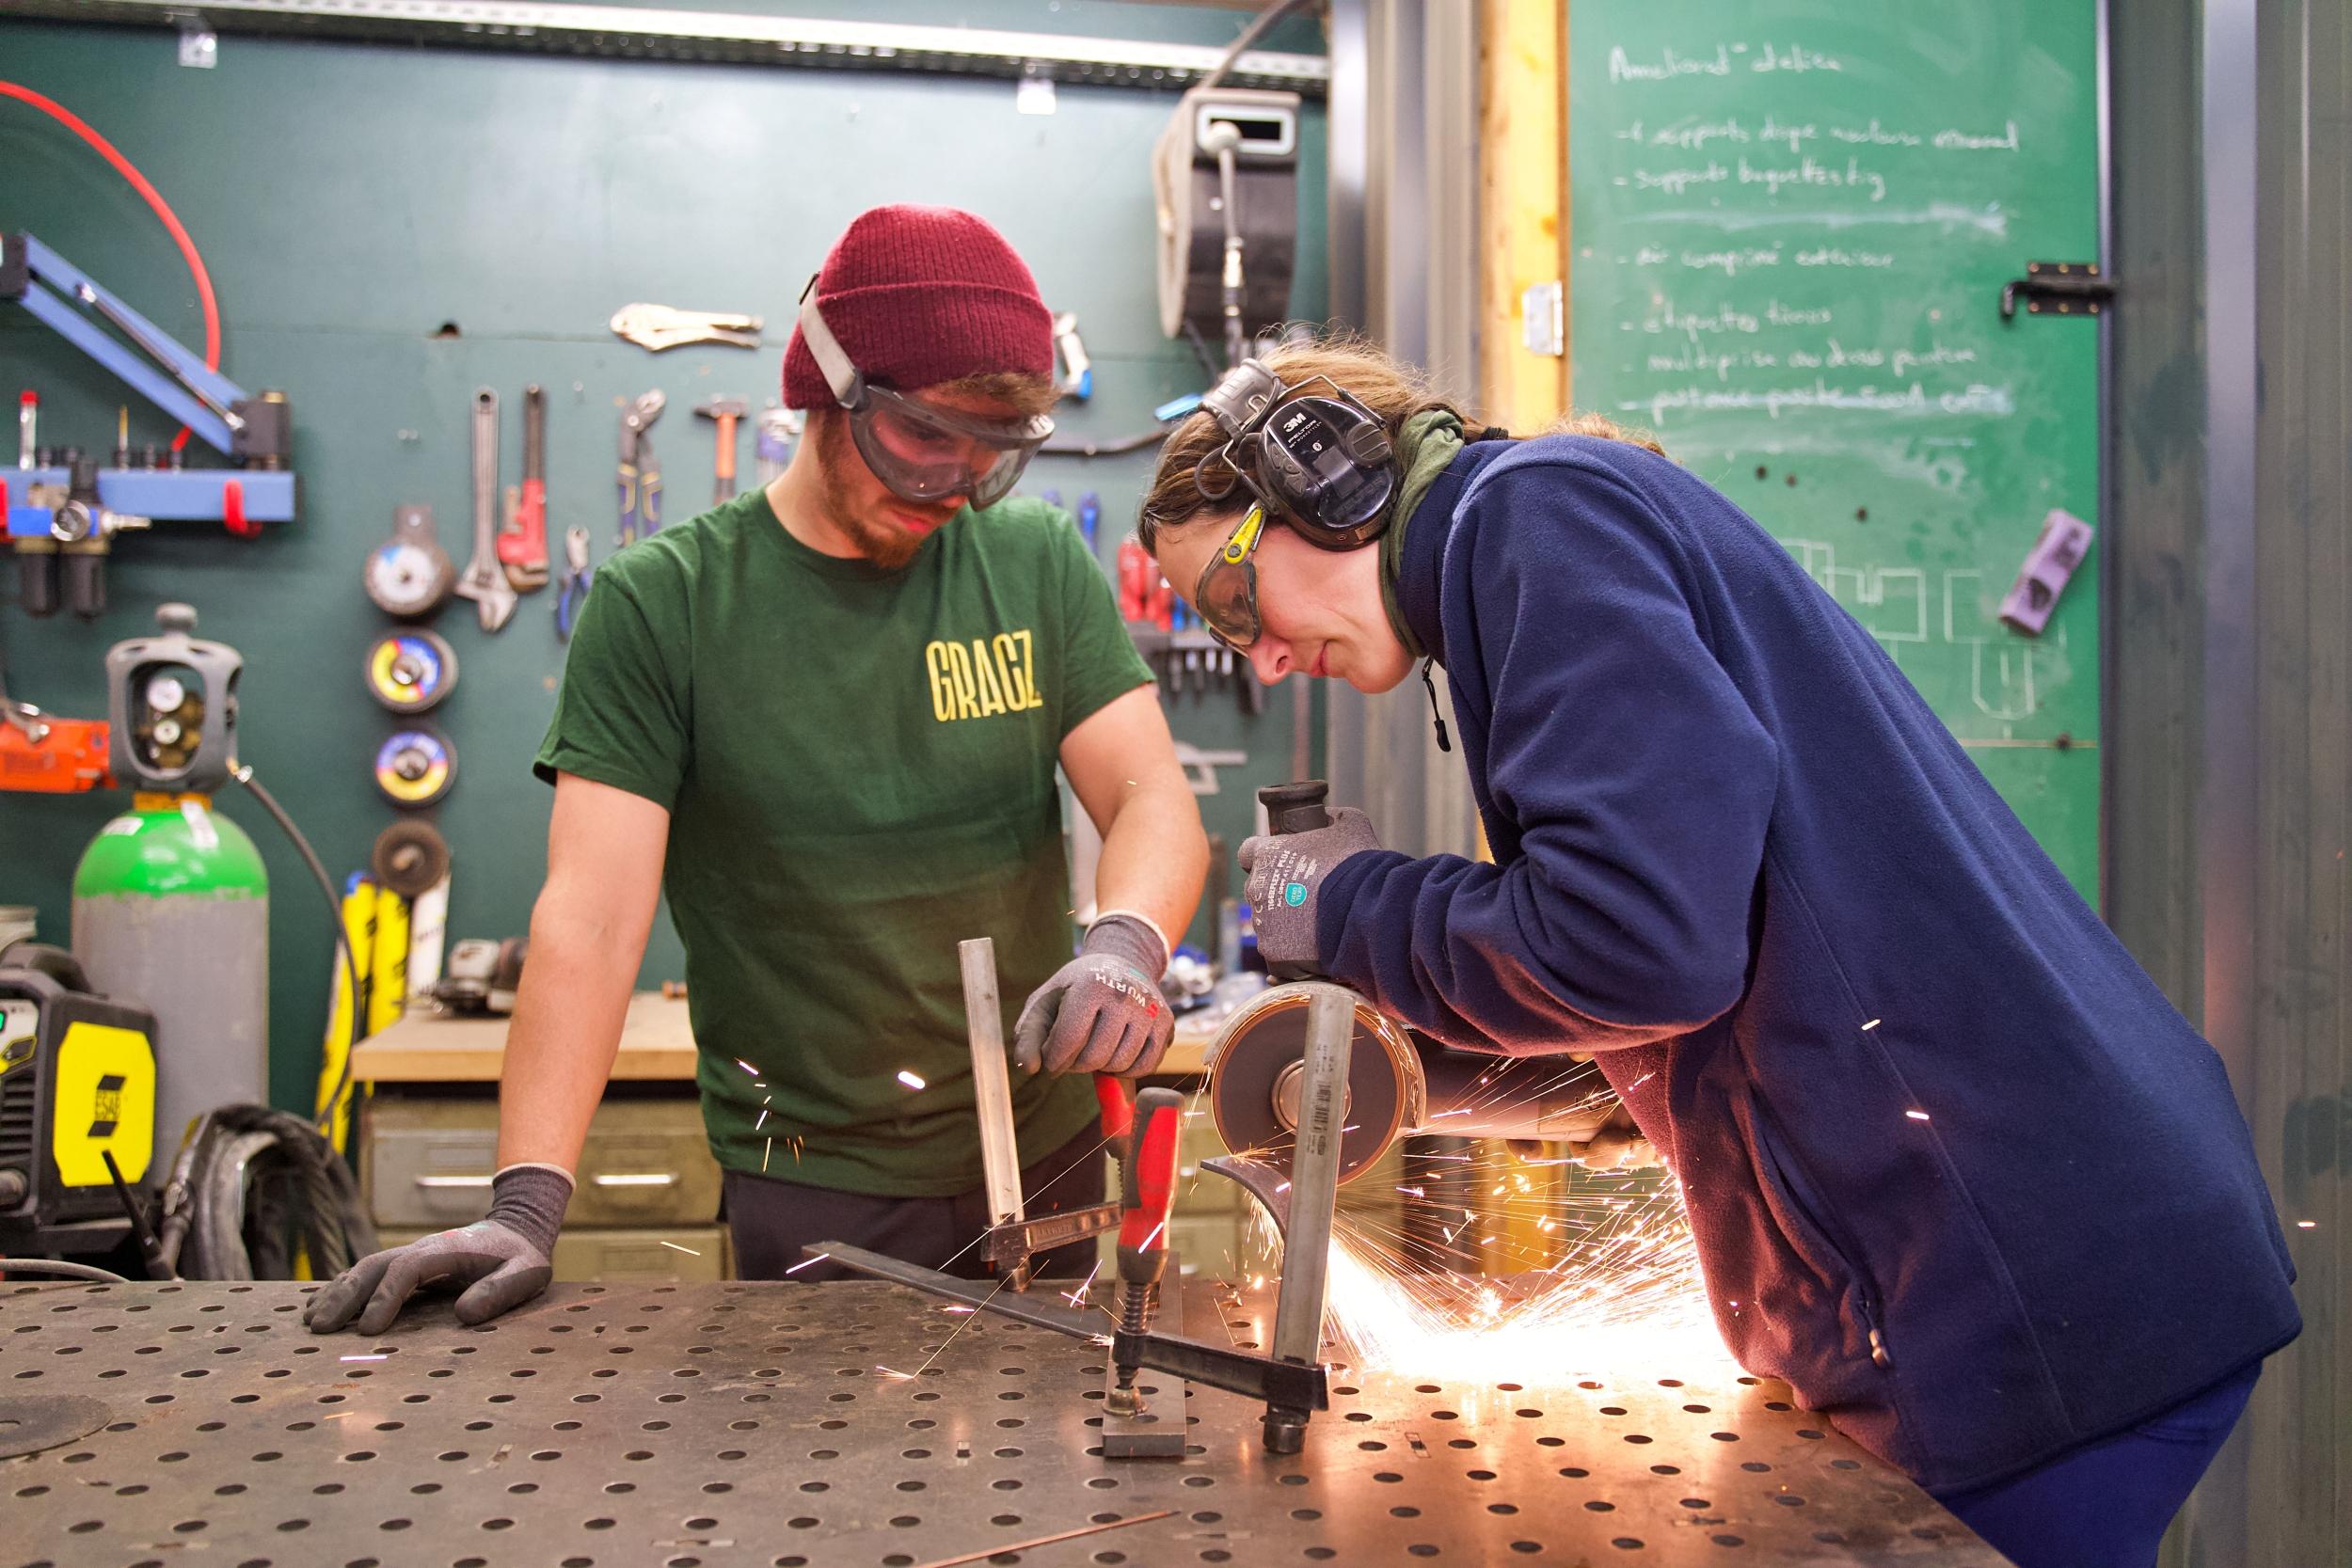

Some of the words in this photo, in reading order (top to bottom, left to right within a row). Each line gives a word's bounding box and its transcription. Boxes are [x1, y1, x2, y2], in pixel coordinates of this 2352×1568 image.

[1283, 412, 1307, 433] 3M
[1288, 420, 1316, 443] PELTOR
[926, 628, 1043, 723] GRACZ
[1277, 849, 1290, 866] PLUS
